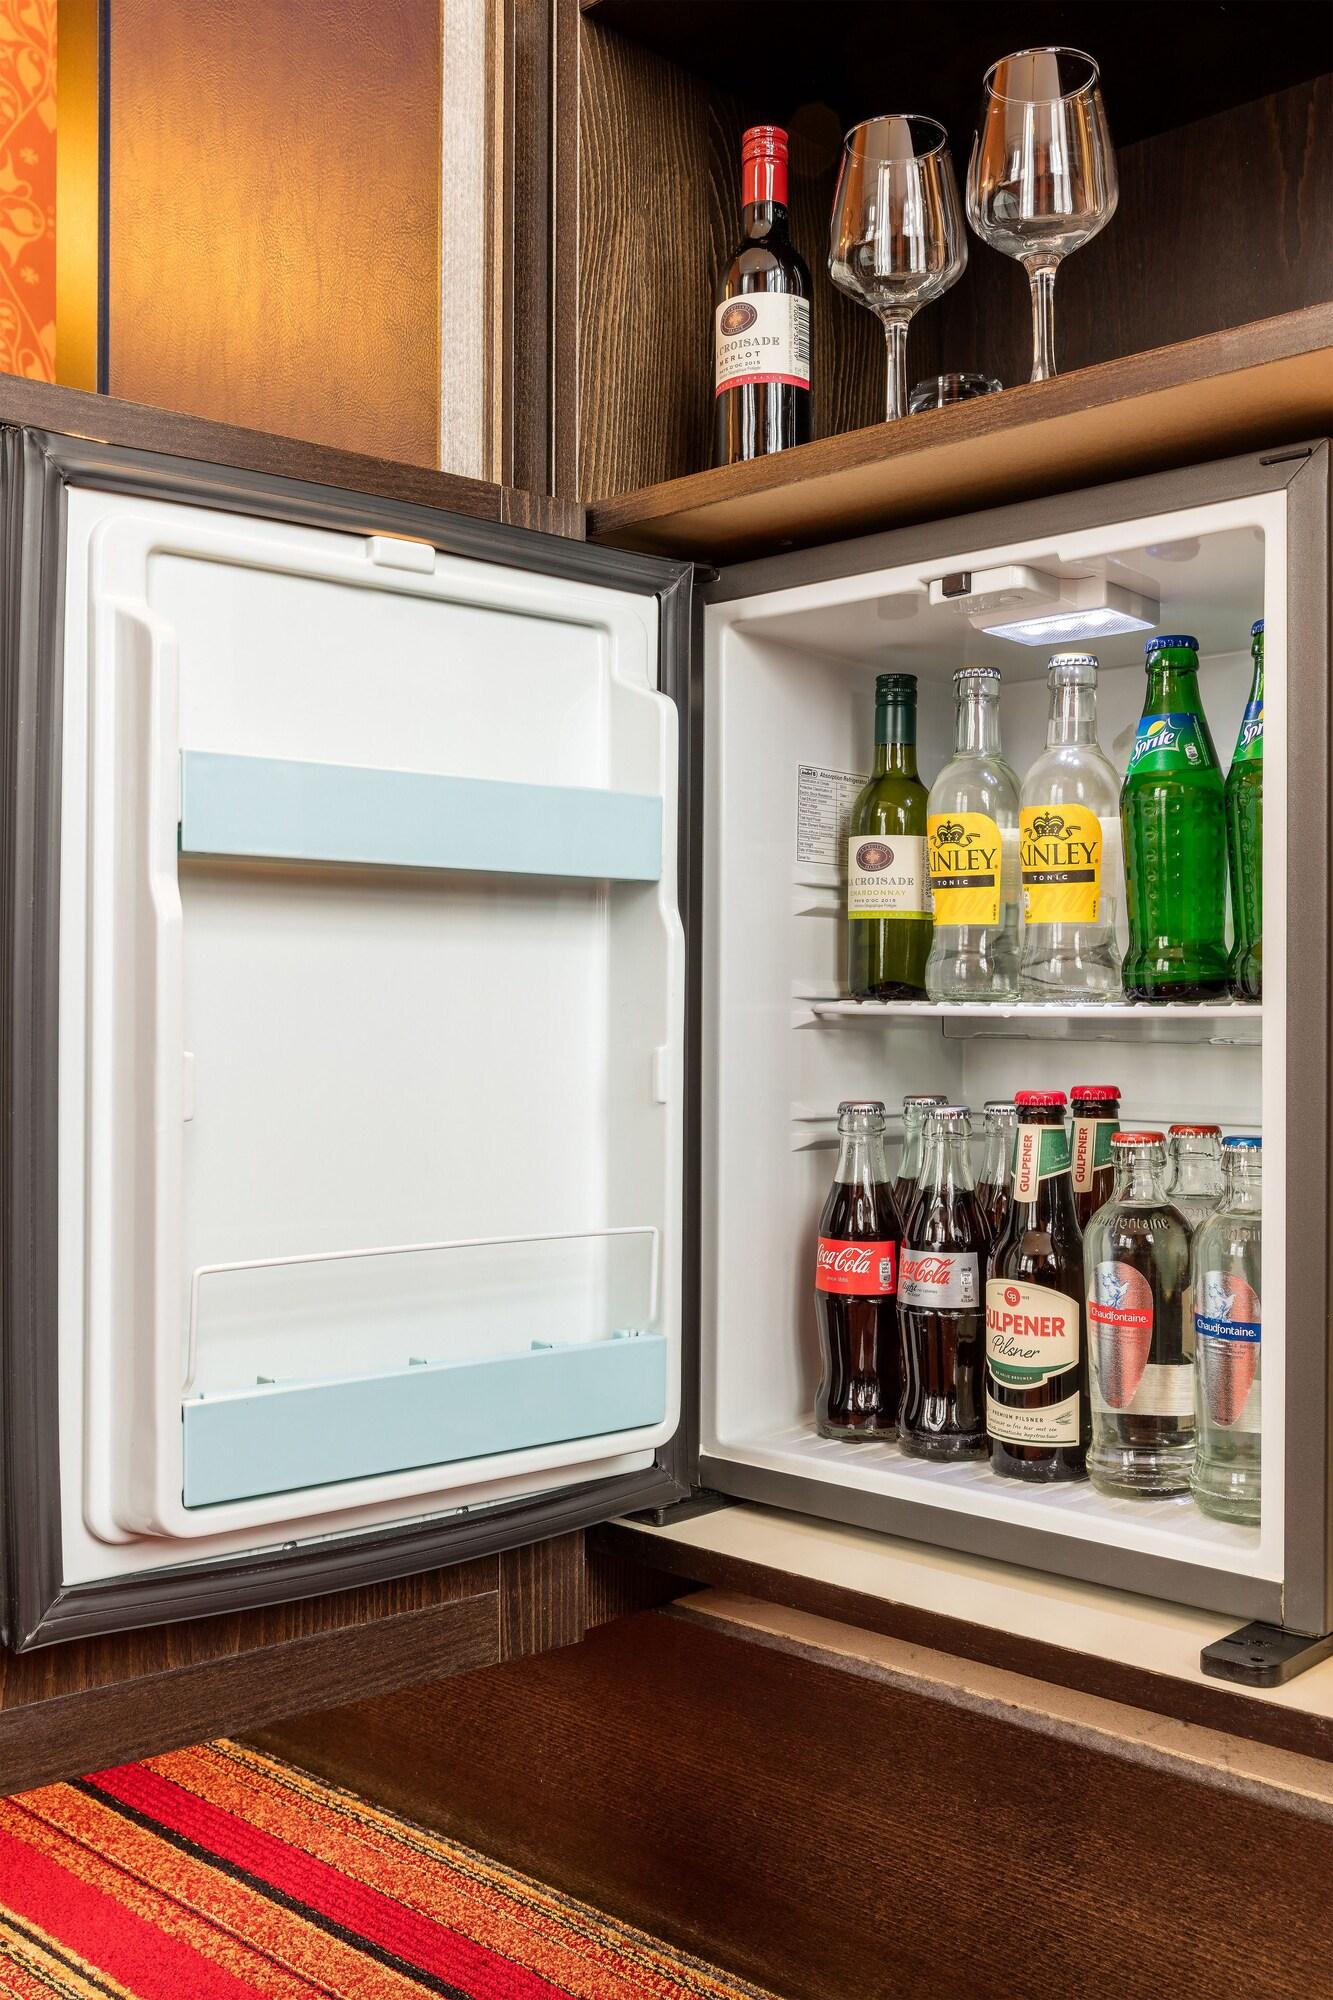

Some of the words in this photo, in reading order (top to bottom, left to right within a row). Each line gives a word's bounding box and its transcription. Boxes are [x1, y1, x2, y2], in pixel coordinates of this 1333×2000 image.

[719, 350, 761, 367] MERLOT
[1131, 729, 1175, 761] Sprite
[1020, 1134, 1033, 1193] GULPENER
[1075, 1127, 1088, 1183] GULPENER
[992, 1334, 1040, 1359] Pilsner
[992, 1409, 1013, 1419] PREMIUM
[1015, 1415, 1044, 1423] PILSNER
